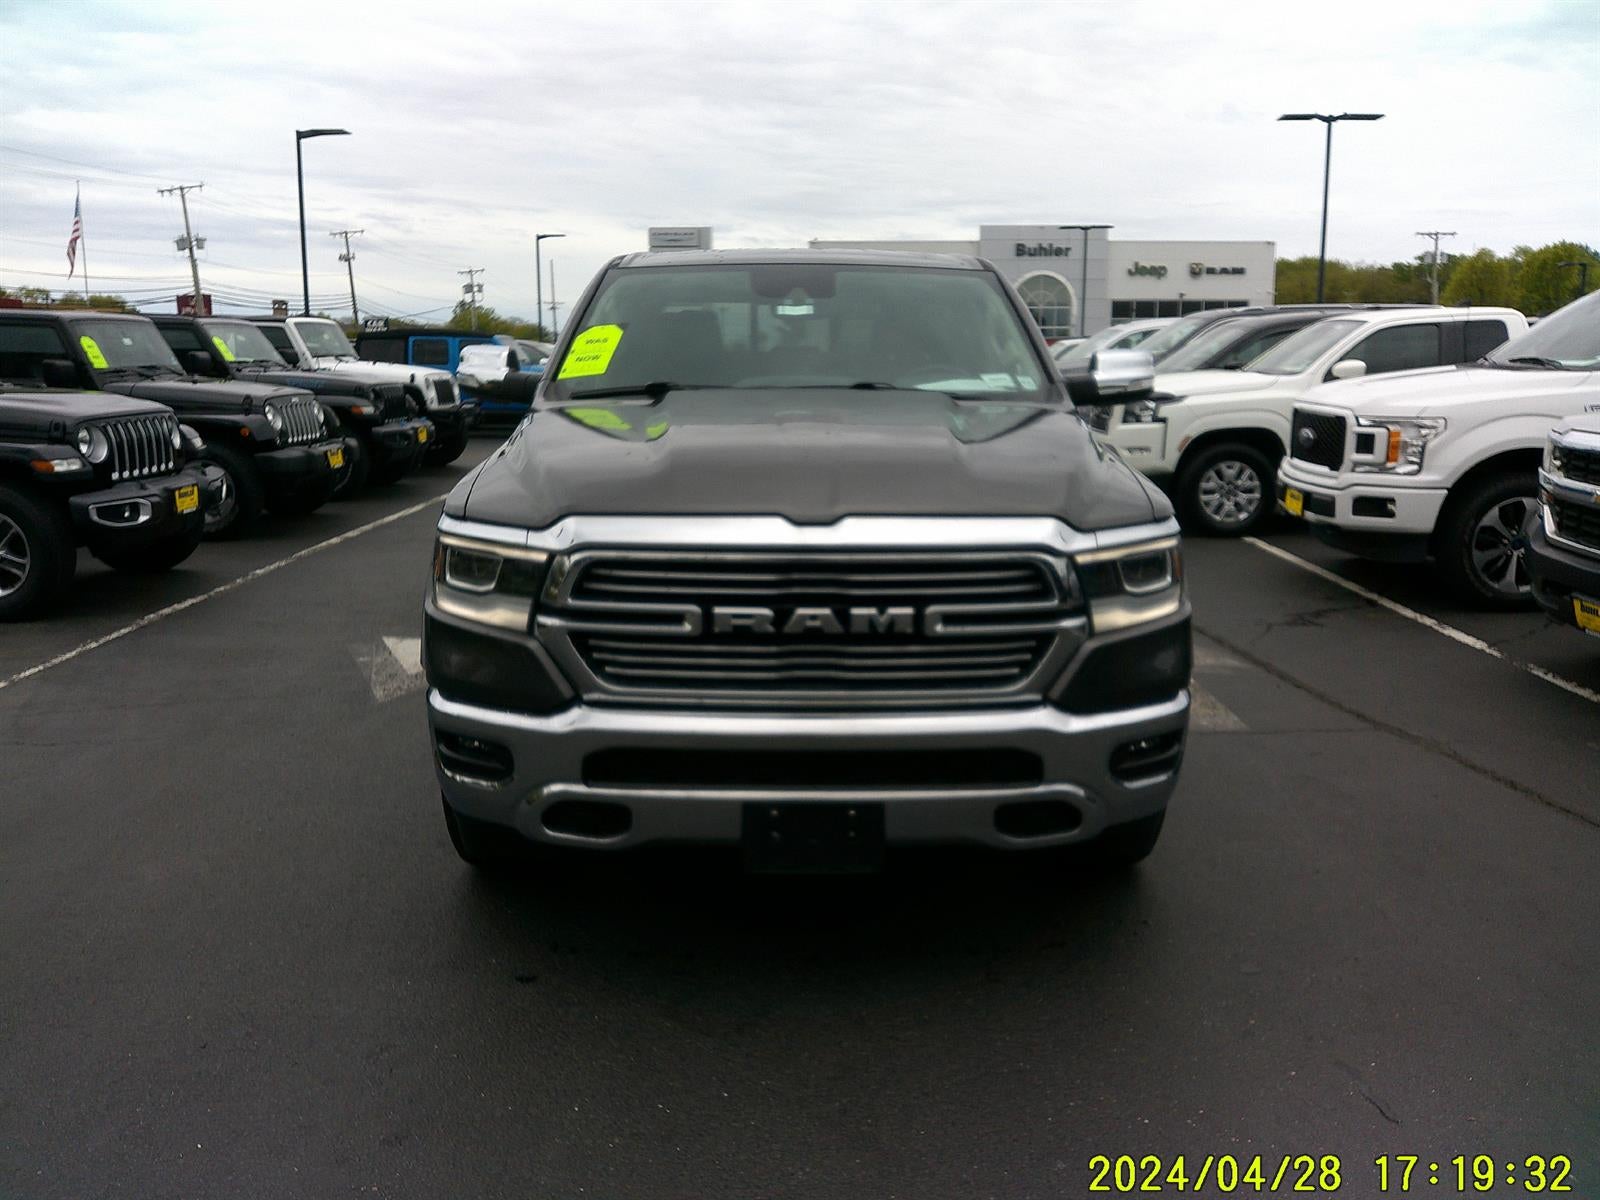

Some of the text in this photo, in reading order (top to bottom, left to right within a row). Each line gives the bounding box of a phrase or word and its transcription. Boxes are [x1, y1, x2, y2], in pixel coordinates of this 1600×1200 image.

[1015, 243, 1072, 257] Buhler
[1127, 261, 1168, 280] Jeep
[1205, 267, 1245, 275] RAM
[575, 354, 601, 362] NOW
[713, 606, 914, 633] RAM
